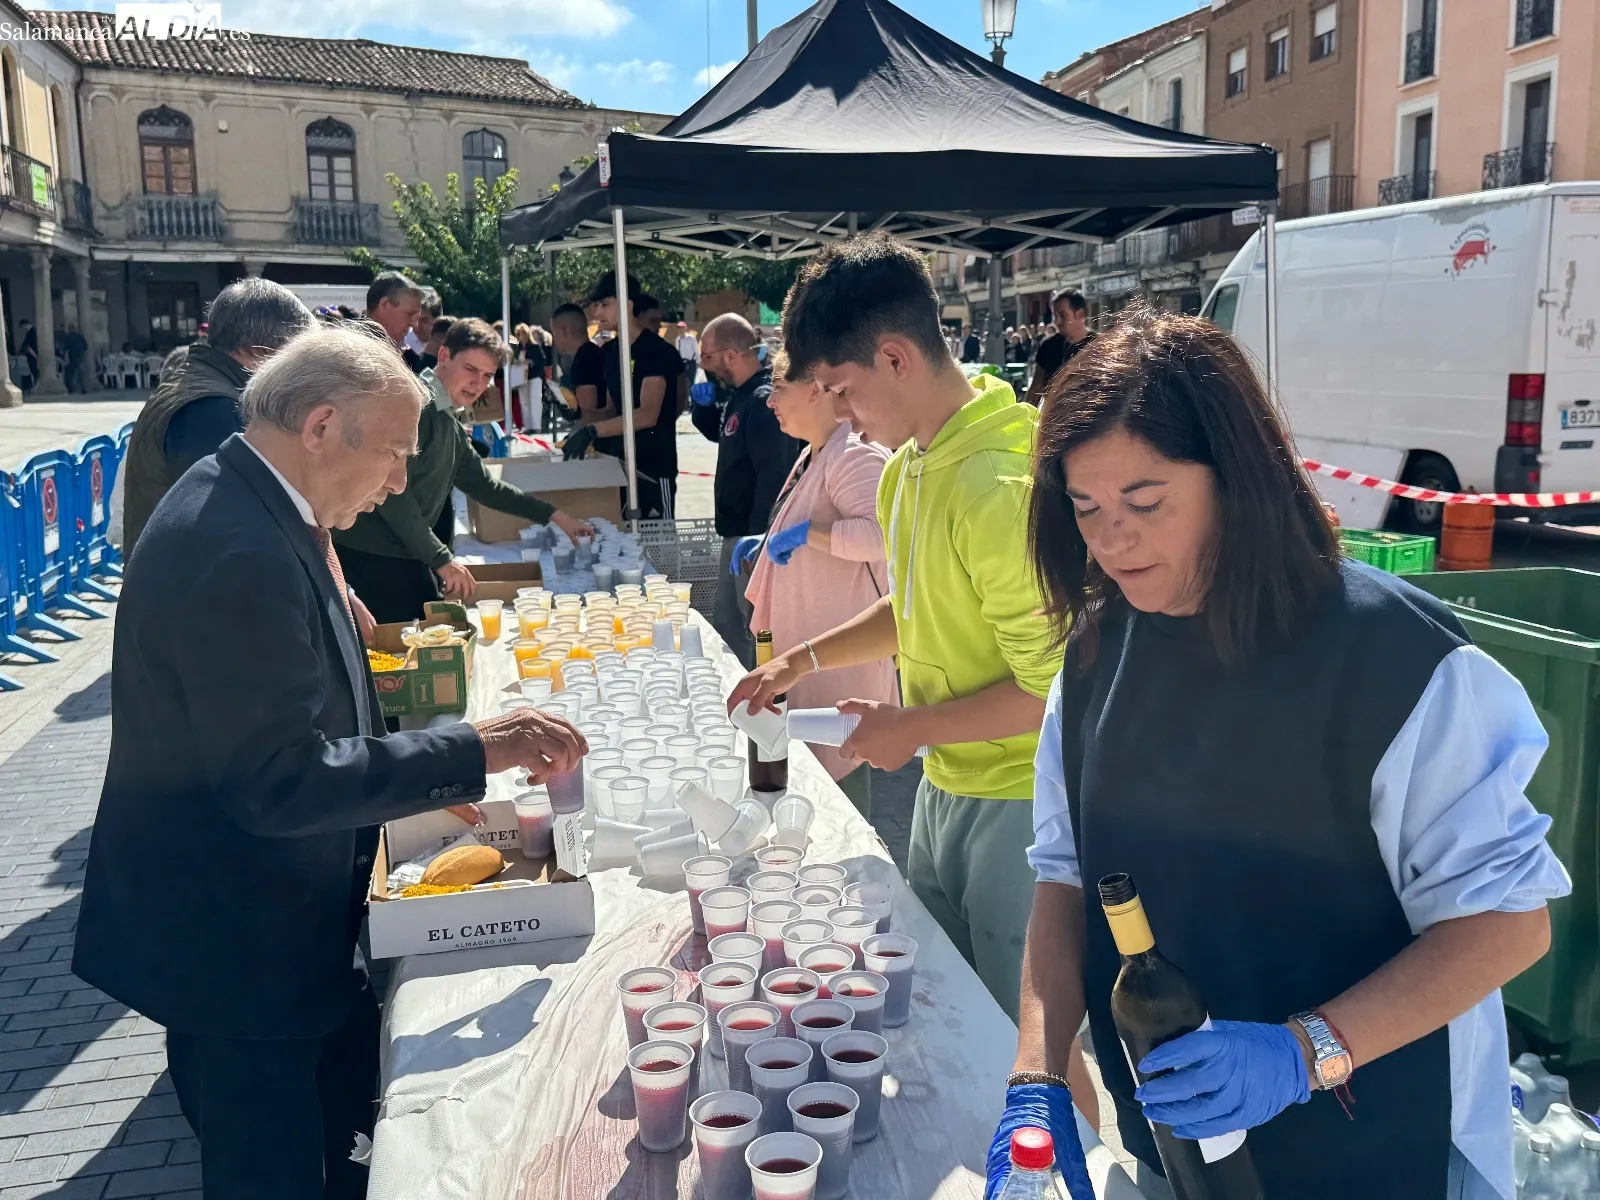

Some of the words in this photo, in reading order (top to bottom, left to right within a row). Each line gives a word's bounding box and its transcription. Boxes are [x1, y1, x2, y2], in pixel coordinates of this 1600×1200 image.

[427, 928, 454, 942] EL
[460, 918, 541, 938] CATETO
[454, 939, 496, 949] ALMAGRO
[498, 936, 517, 944] 1969
